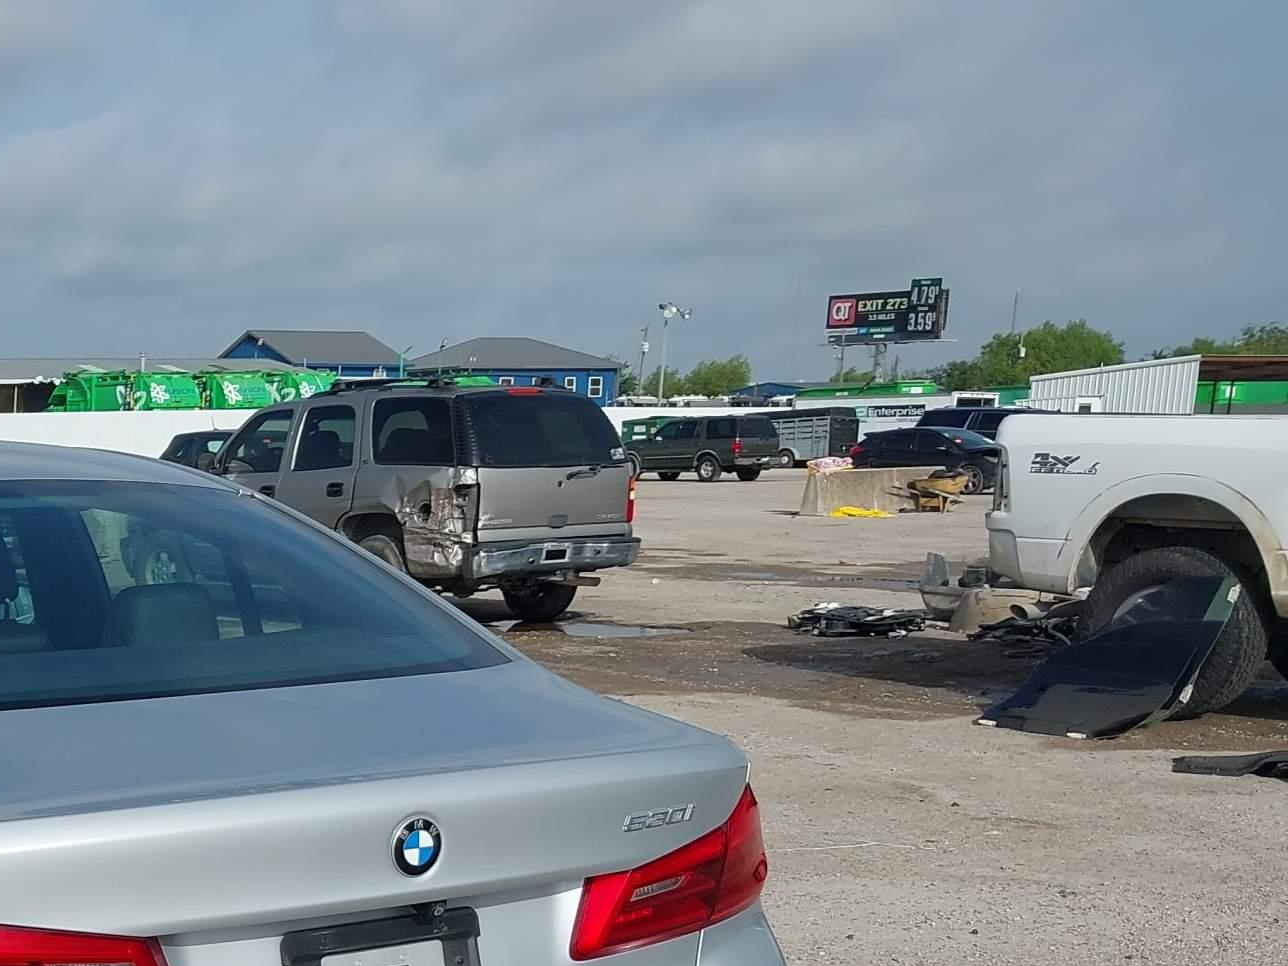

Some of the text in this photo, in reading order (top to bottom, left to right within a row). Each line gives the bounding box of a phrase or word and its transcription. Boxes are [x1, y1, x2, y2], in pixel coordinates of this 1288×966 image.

[832, 302, 852, 321] QT
[857, 298, 909, 312] EXIT 273
[868, 405, 925, 417] Enterprise
[399, 819, 439, 840] BMW
